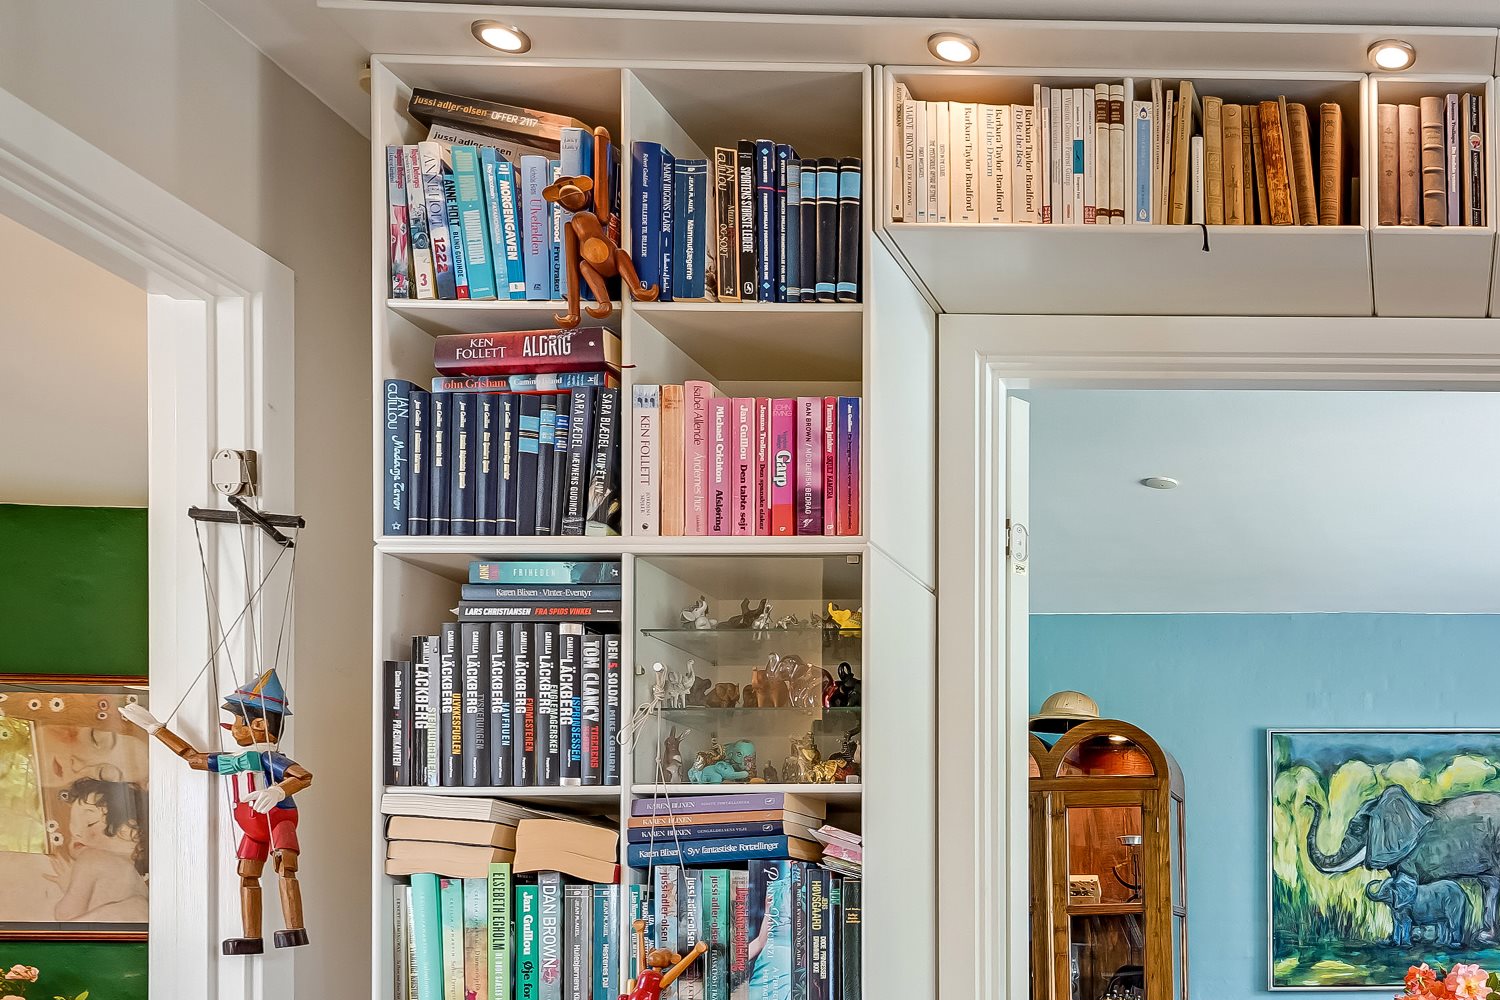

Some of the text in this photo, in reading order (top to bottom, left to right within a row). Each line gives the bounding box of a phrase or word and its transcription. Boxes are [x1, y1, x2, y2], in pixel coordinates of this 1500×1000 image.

[414, 95, 538, 127] jussi adler-olsen OFFER 2117
[1016, 109, 1023, 119] To
[1016, 121, 1023, 132] Be
[718, 153, 727, 190] GUILLOU
[1024, 109, 1034, 212] Barbara Taylor Bradford
[444, 180, 460, 226] ANNE HOLT
[499, 180, 518, 260] MORGENGAVEN
[741, 167, 753, 253] SPORTENS STØRSTE LEDERE
[529, 199, 543, 256] Ulvefælden
[686, 220, 694, 280] Mammutjægerne
[433, 238, 448, 273] 1222
[420, 274, 428, 286] 3
[456, 348, 506, 360] FOLLETT
[470, 339, 493, 348] KEN
[523, 336, 571, 356] ALDRIG
[388, 383, 399, 429] GUILLOU
[398, 399, 409, 417] JAN
[572, 393, 585, 448] SARA BLÆDEL
[599, 393, 612, 448] SARA BLÆDEL
[693, 385, 703, 445] Isabel Allende
[390, 435, 406, 511] Madame Terror
[640, 415, 650, 486] KEN FOLLETT
[774, 450, 792, 487] Garp
[583, 641, 599, 669] TOM
[608, 641, 618, 706] DEN SOLDAT
[442, 654, 454, 713] LÄCKBERG
[492, 654, 503, 713] LÄCKBERG
[515, 655, 528, 714] LÄCKBERG
[539, 656, 551, 714] LÄCKBERG
[560, 659, 576, 725] LÄCKBERG
[584, 673, 599, 721] CLANCY
[493, 873, 504, 951] ELSEBETH EGHOLM
[523, 892, 532, 912] Jan
[524, 915, 532, 955] Guillou
[543, 886, 556, 969] DAN BROWN
[523, 961, 532, 980] Øje
[524, 984, 533, 998] for
